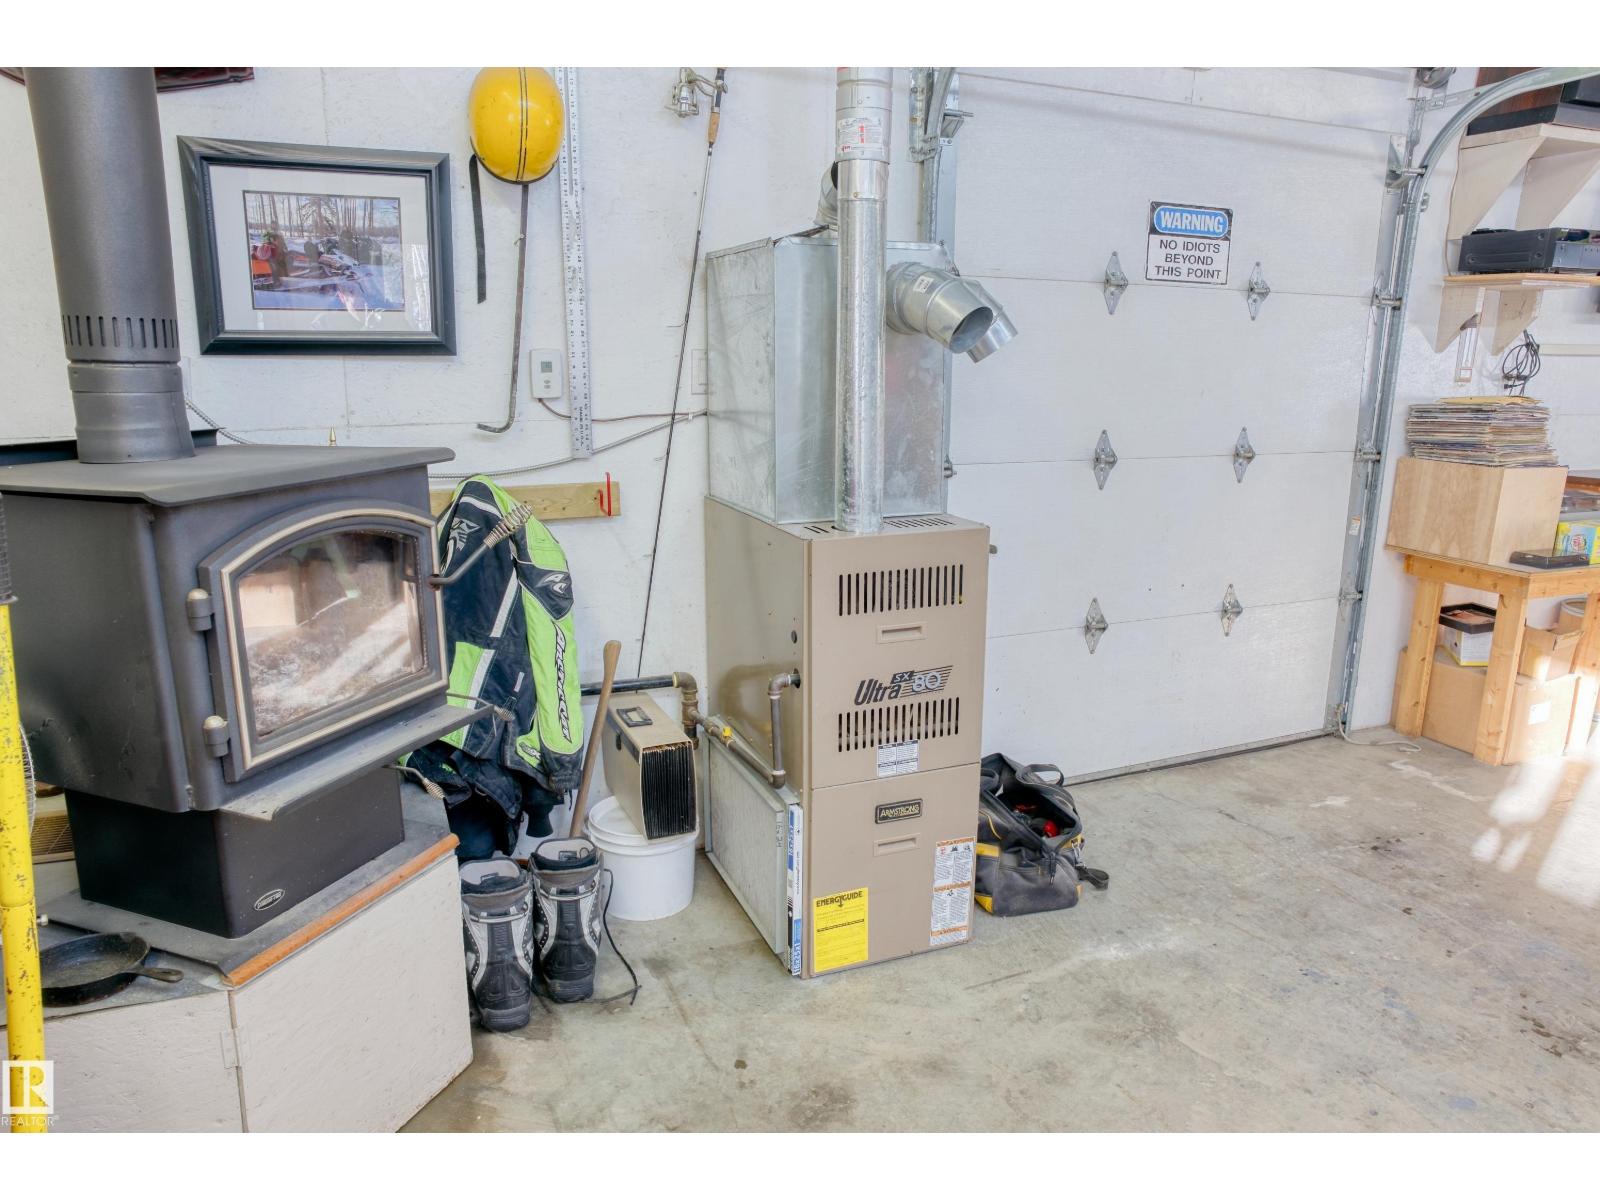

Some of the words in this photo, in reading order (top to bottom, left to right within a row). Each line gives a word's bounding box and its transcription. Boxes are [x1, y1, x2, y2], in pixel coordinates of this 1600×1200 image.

[1160, 210, 1224, 233] WARNING
[1159, 239, 1178, 250] NO
[1182, 240, 1221, 254] IDIOTS
[1165, 253, 1214, 266] BEYOND
[1154, 265, 1182, 277] THIS
[1186, 267, 1222, 280] POINT
[854, 678, 902, 706] Ultra
[912, 671, 941, 692] 80
